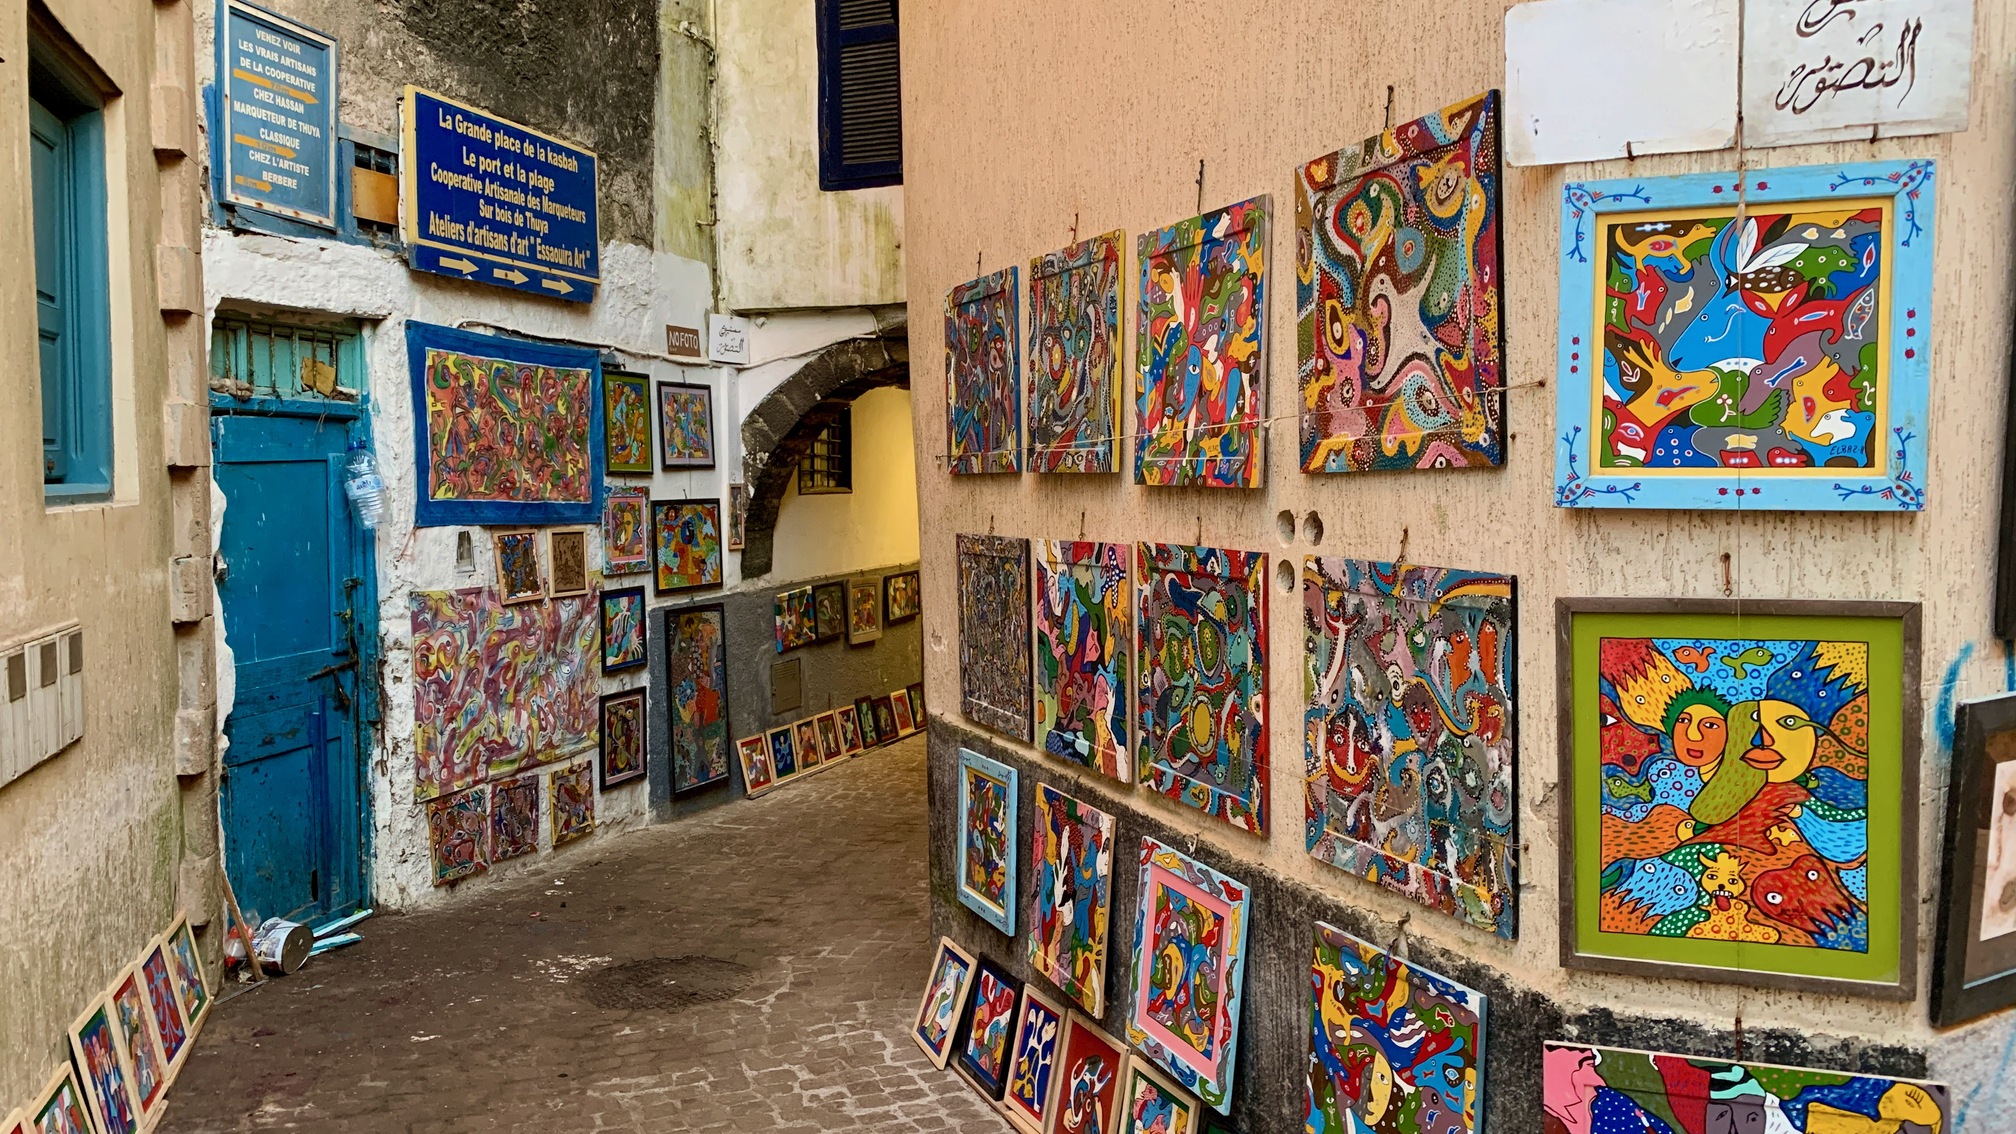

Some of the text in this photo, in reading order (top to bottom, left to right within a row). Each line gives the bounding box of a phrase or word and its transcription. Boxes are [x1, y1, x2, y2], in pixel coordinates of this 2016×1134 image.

[238, 39, 316, 76] LES VRAIS ARTISANS
[256, 29, 301, 54] VENEZ VOIR
[240, 57, 315, 92] DE LA COOPERATIVE
[254, 88, 304, 114] CHEZ HASSAN
[234, 101, 320, 139] MARQUETEUR DE THUYA
[260, 128, 300, 150] CLASSIQUE
[439, 107, 578, 173] La Grande place de la kasbah
[249, 150, 309, 176] CHEZ L'ARTISTE
[262, 170, 297, 189] BERBERE
[463, 146, 555, 194] Le port et la plage
[431, 162, 586, 224] Cooperative Artisanale des Marqueteurs
[429, 211, 464, 242] Ateliers
[467, 221, 508, 252] d'artisans
[479, 199, 548, 236] Sur bois de Thuya
